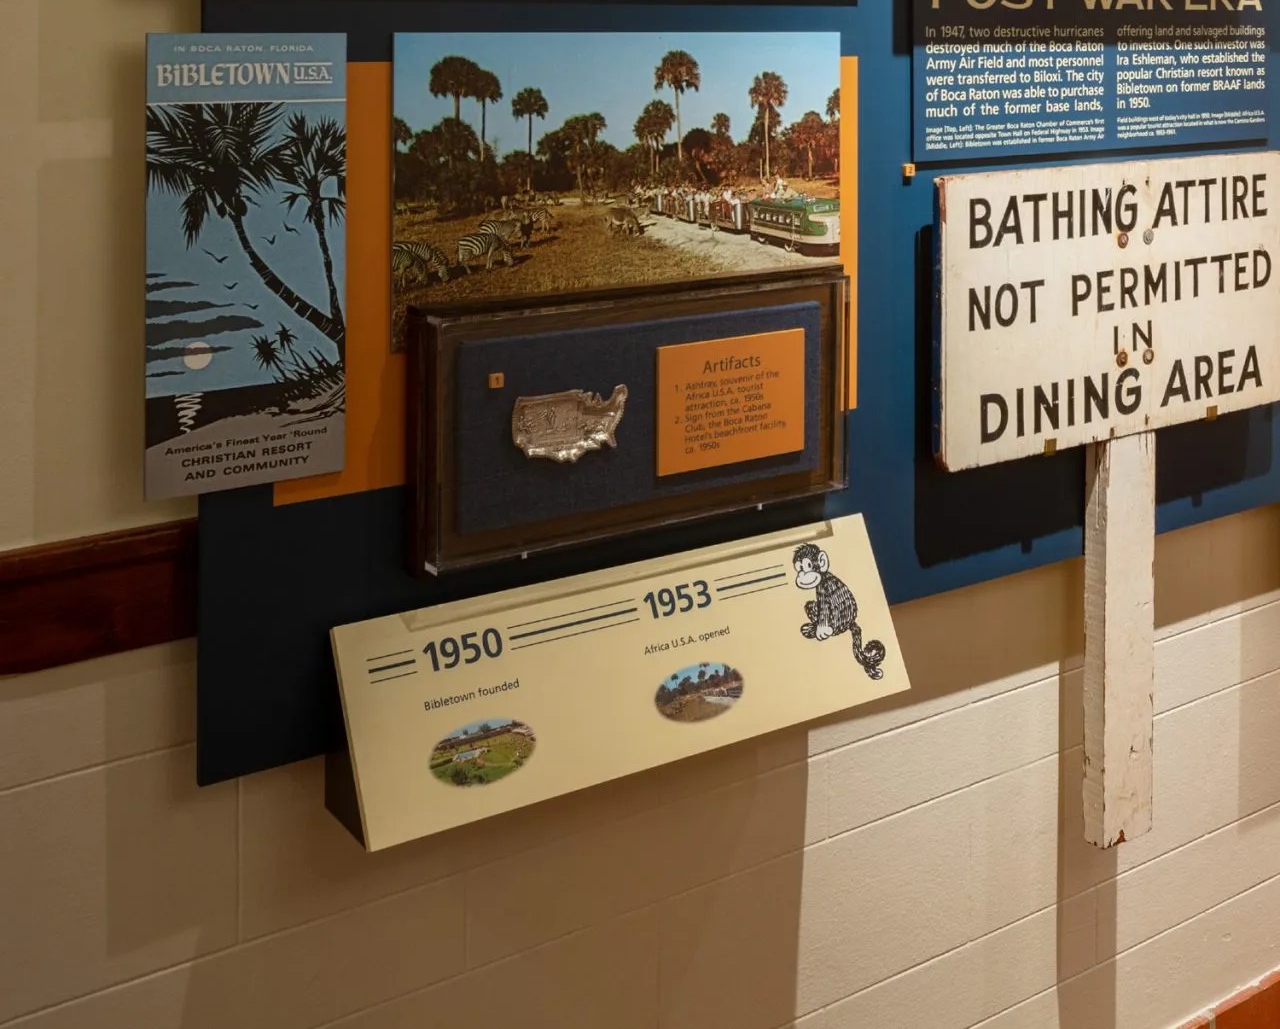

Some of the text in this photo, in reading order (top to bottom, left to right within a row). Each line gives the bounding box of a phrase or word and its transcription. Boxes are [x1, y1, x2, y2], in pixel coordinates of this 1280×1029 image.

[926, 25, 1104, 39] In 1947, two destructive hurricanes
[1117, 25, 1265, 38] offering land and salvaged buildings
[926, 40, 1104, 56] destroyed much of the Boca Raton
[1118, 39, 1265, 51] to investors. One such investor was
[926, 54, 1104, 72] Army Air Field and most personnel
[1117, 52, 1265, 66] Ira Eshleman, who established the
[294, 66, 332, 80] U.S.A.
[926, 70, 1104, 85] were transferred to Biloxi. The city
[1117, 66, 1265, 83] popular Christian resort known as
[926, 84, 1104, 102] of Boca Raton was able to purchase
[1117, 78, 1265, 94] Bibletown on former BRAAF lands
[926, 99, 1103, 118] much of the former base lands,
[1117, 96, 1150, 108] in 1950.
[969, 174, 1268, 249] BATHING ATTIRE
[969, 249, 1271, 332] NOT PERMITTED
[1114, 320, 1154, 357] IN
[703, 356, 760, 374] Artifacts
[980, 345, 1262, 444] DINING AREA
[165, 442, 222, 456] America's
[226, 437, 260, 447] Finest
[262, 434, 288, 442] Year
[182, 441, 312, 467] CHRISTIAN RESORT
[185, 455, 309, 481] AND COMMUNITY
[643, 580, 712, 619] 1953
[644, 626, 730, 655] Africa U.S.A. opened
[422, 628, 502, 672] 1950
[424, 678, 519, 711] Bibletown founded
